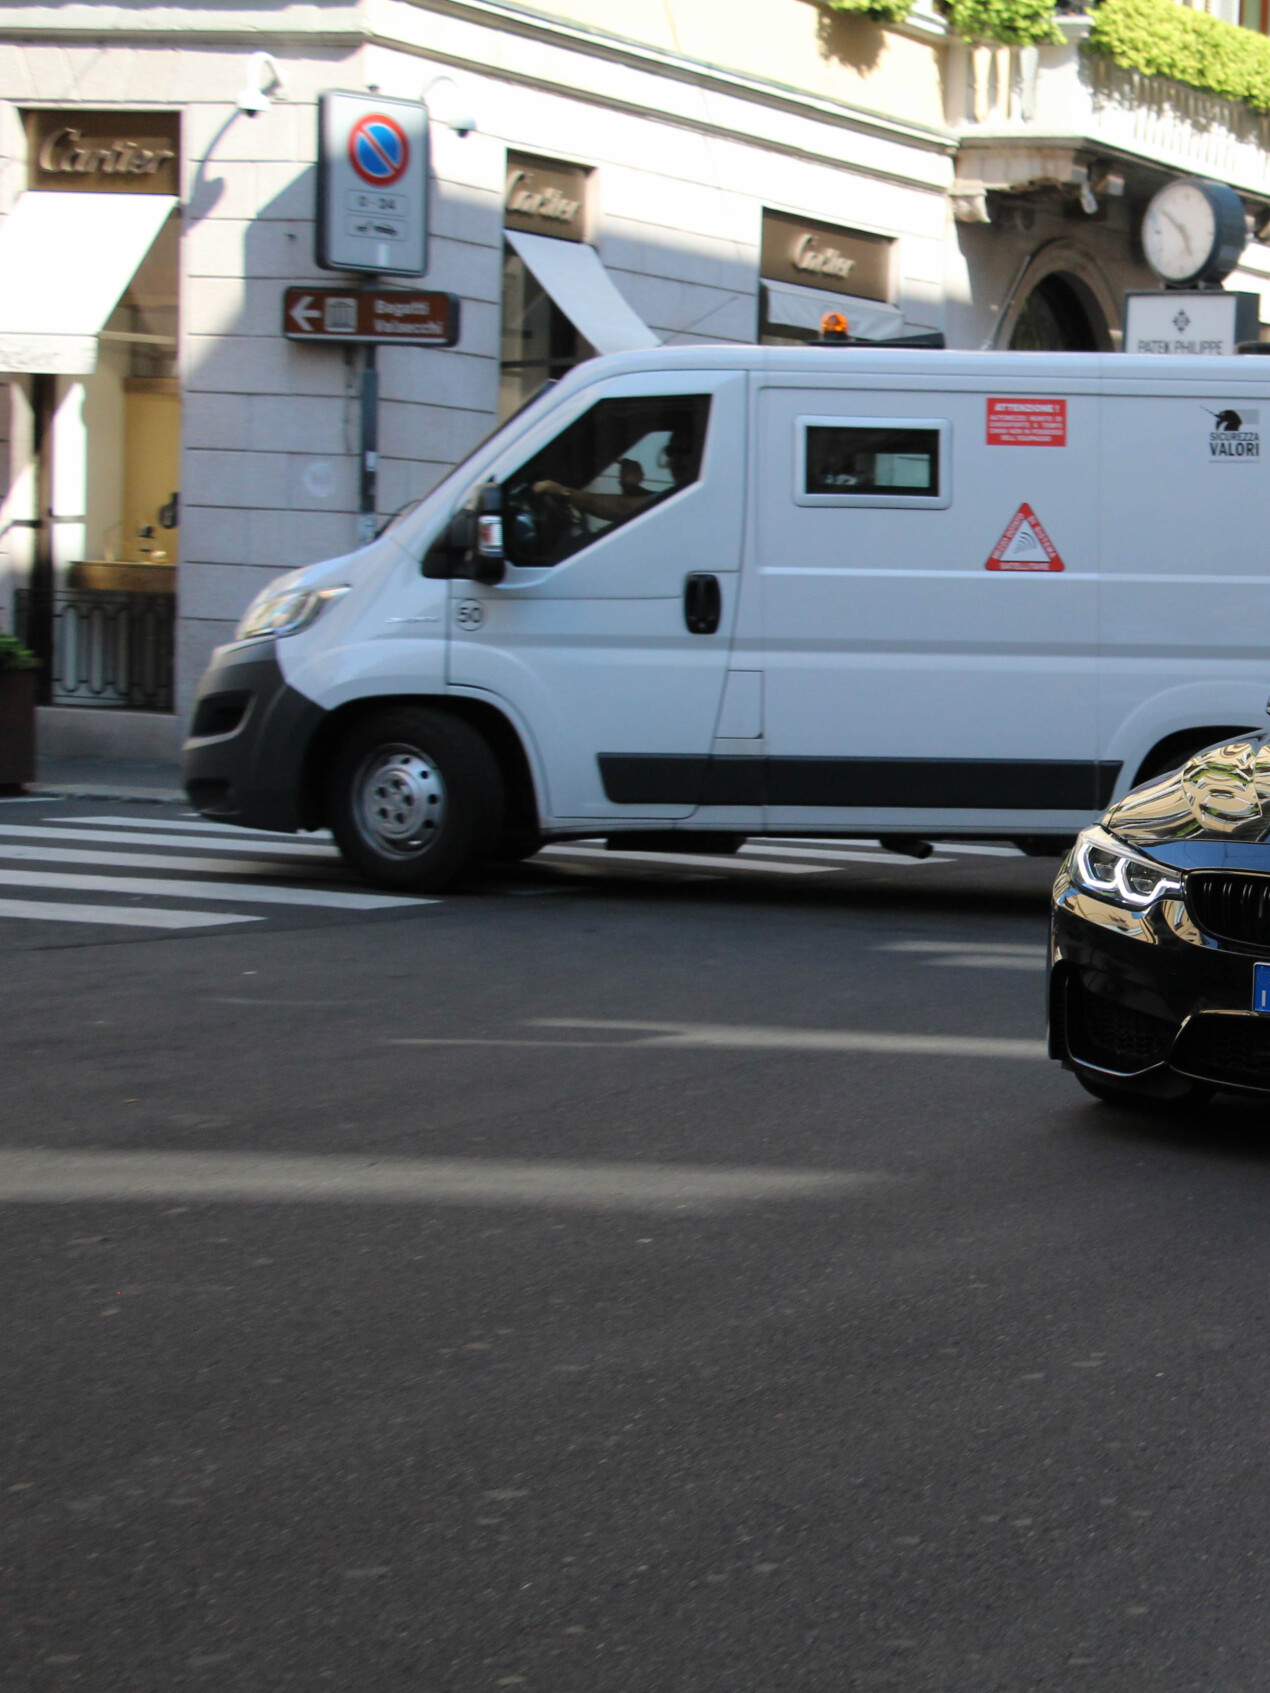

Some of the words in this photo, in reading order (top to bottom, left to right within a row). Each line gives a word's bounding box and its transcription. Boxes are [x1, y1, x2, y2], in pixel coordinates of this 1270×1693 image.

[39, 126, 175, 174] Cartier
[506, 169, 581, 221] Cartier
[788, 233, 856, 279] Cartier
[1209, 432, 1260, 442] SICUREZZA
[1209, 442, 1260, 457] VALORI
[457, 606, 482, 623] 50
